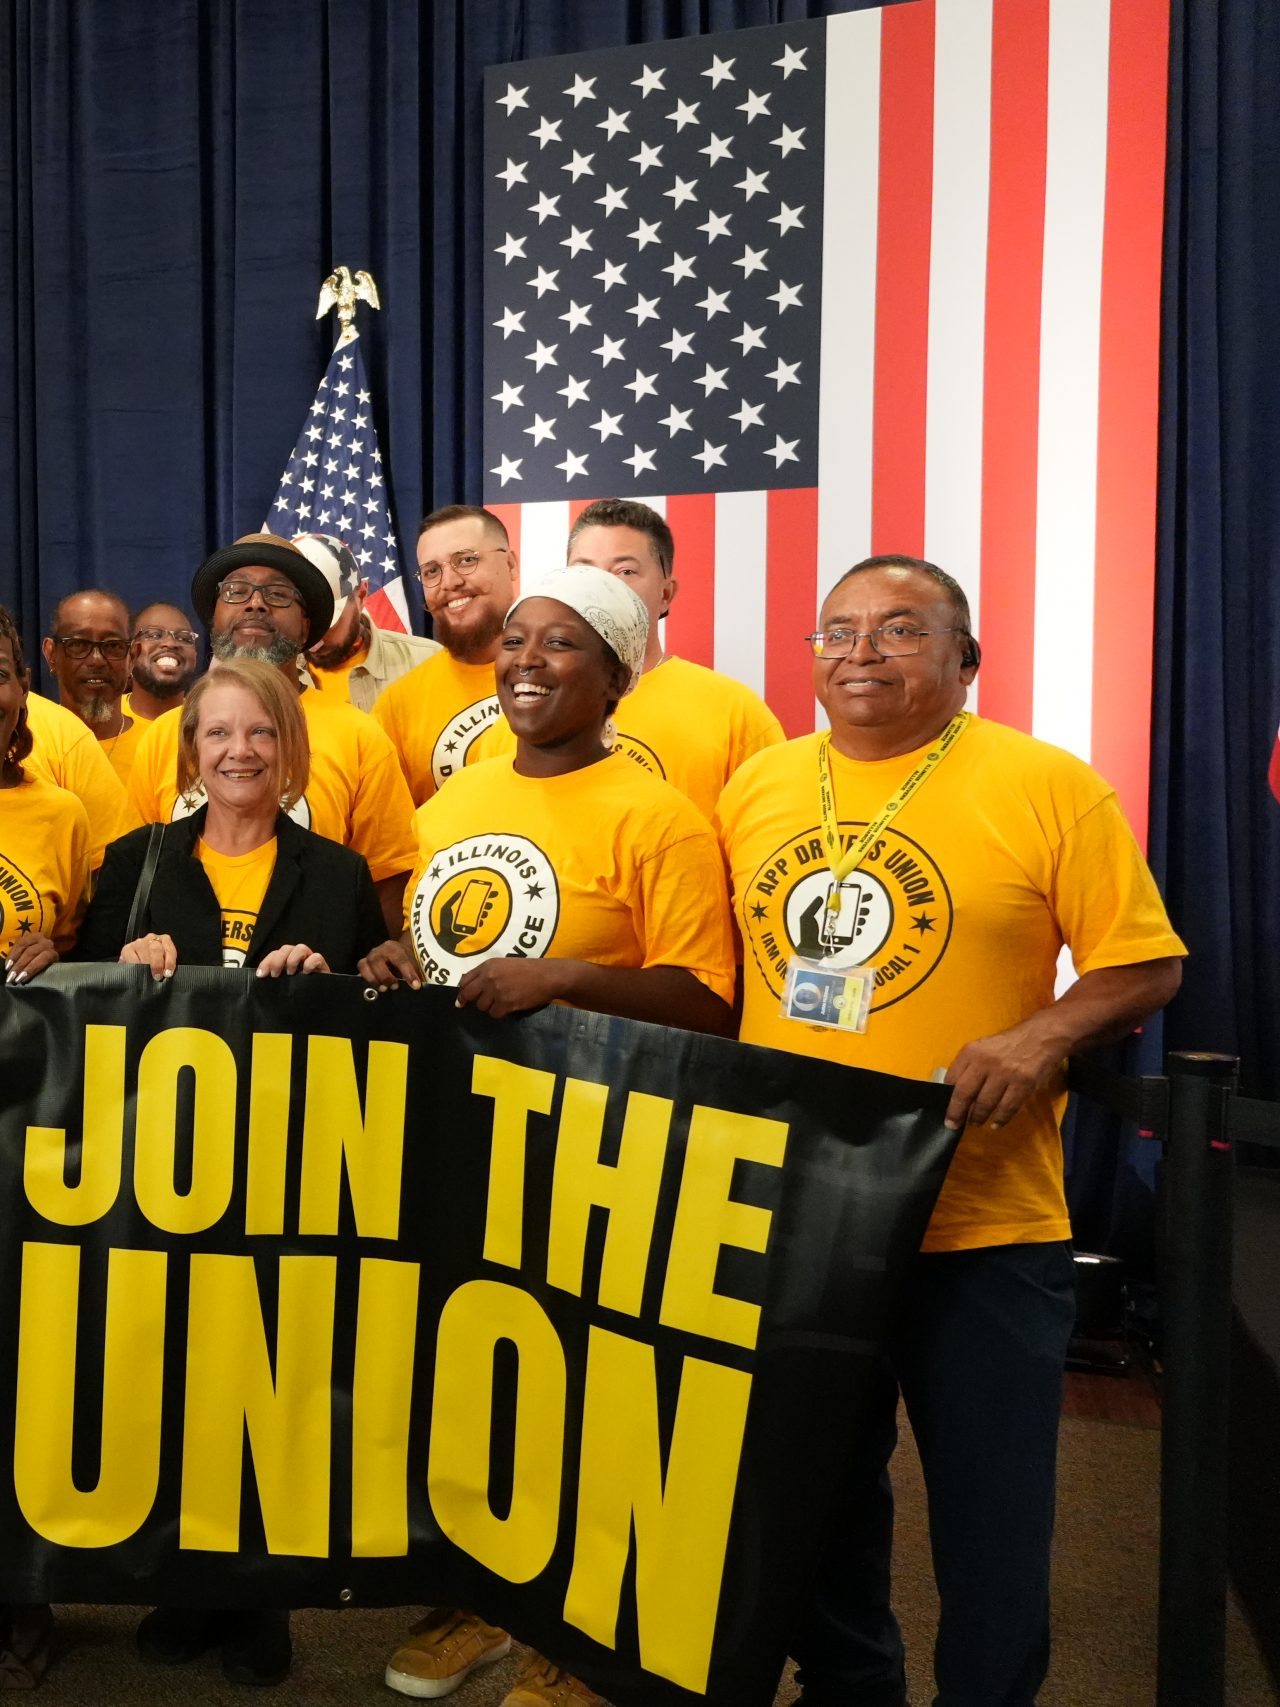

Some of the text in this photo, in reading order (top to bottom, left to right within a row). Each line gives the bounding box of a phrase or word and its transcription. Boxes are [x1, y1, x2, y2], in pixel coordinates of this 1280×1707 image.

[453, 703, 500, 738] ILLIN
[448, 844, 537, 879] ILLINOIS
[756, 858, 788, 897] APP
[884, 848, 936, 908] UNION
[413, 894, 451, 985] DRIVERS
[760, 931, 780, 961] IAM
[871, 943, 920, 990] OCAL 1
[23, 1023, 791, 1351] JOIN THE
[13, 1240, 754, 1695] UNION
